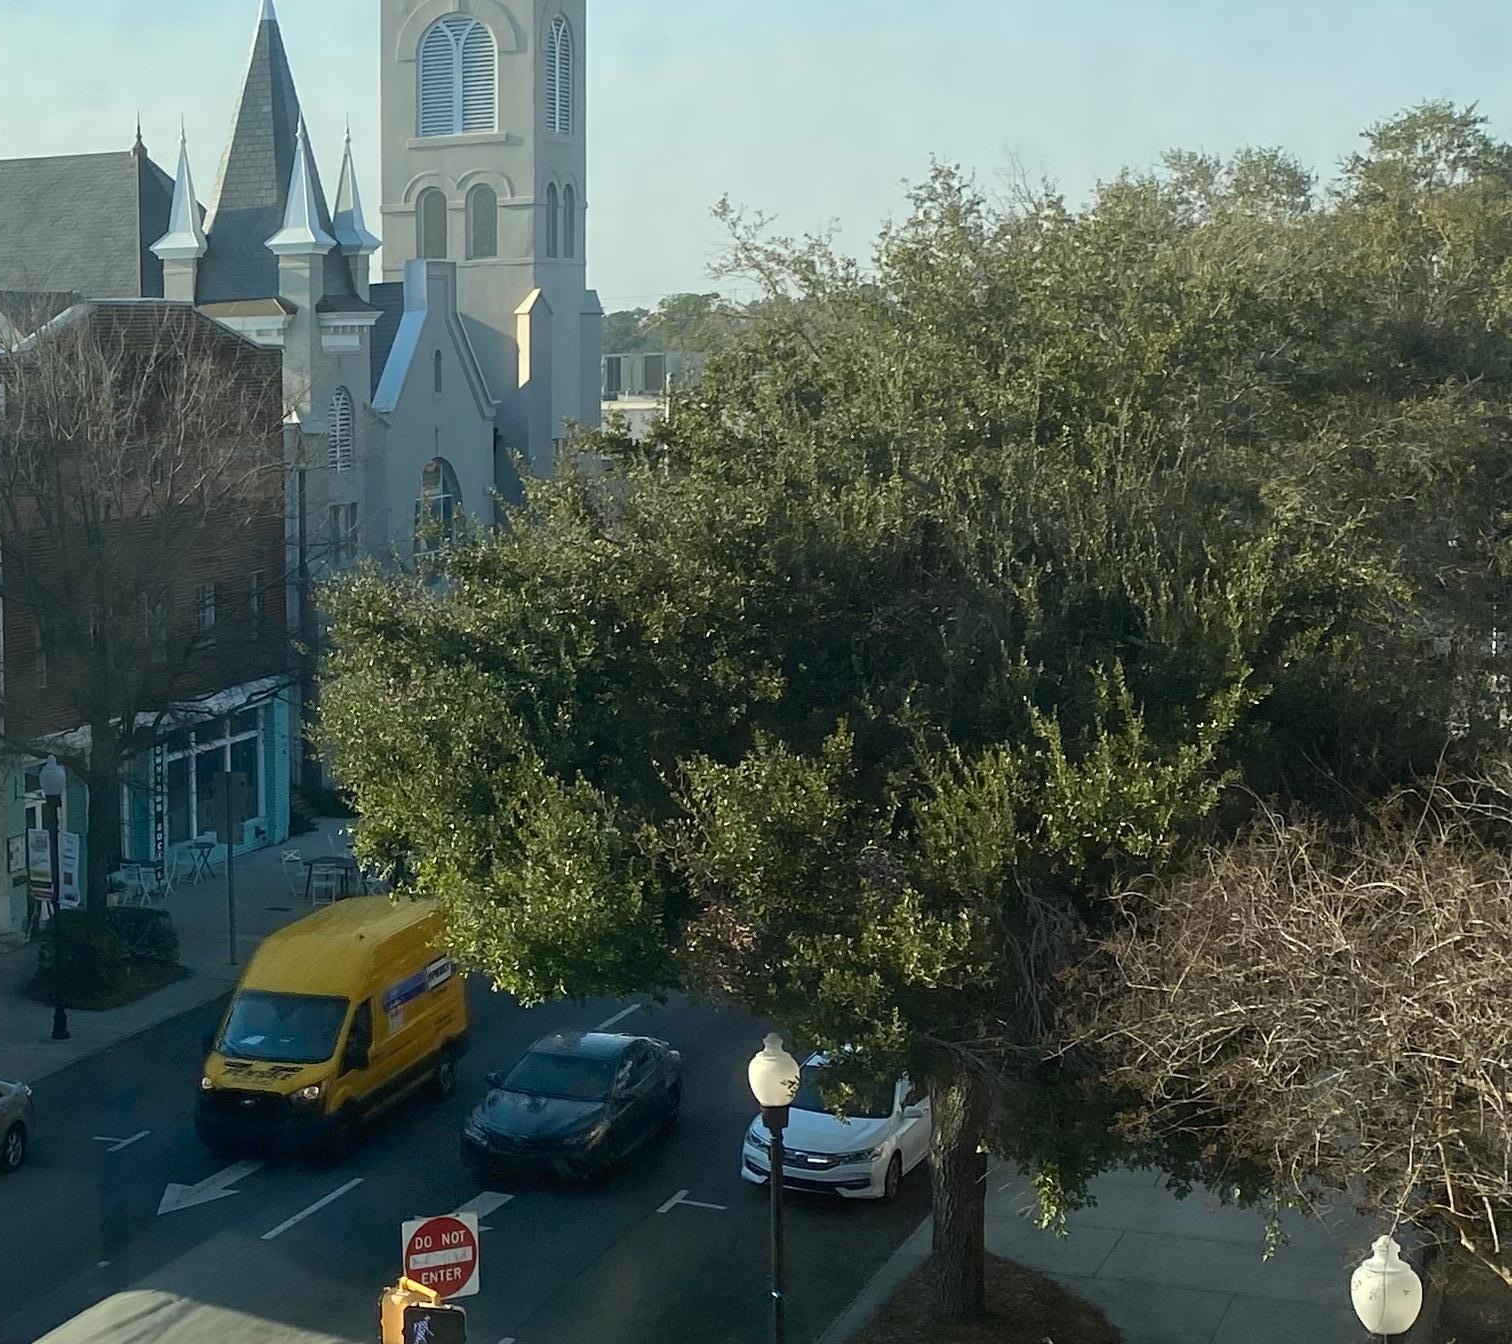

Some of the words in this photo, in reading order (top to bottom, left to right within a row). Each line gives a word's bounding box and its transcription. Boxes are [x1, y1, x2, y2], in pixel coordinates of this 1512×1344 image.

[414, 1235, 433, 1250] DO
[440, 1229, 467, 1246] NOT
[420, 1267, 462, 1285] ENTER
